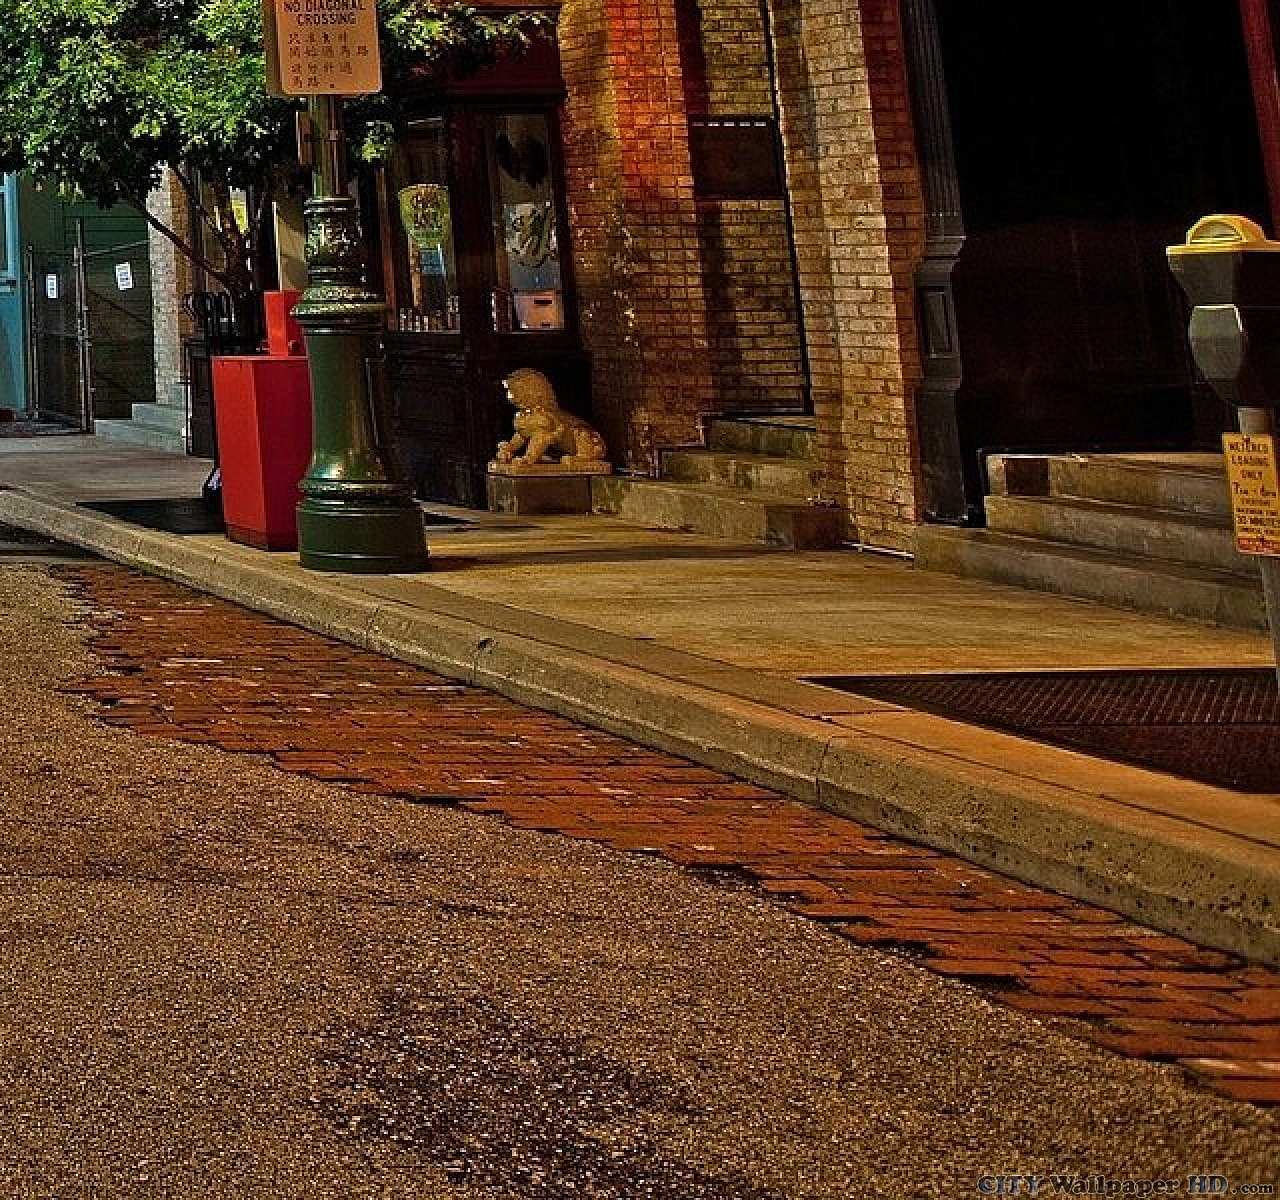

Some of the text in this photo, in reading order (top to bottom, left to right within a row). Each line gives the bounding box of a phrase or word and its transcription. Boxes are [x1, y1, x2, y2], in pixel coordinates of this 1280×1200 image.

[283, 0, 367, 13] NO DIAGONAL
[297, 13, 357, 26] CROSSING
